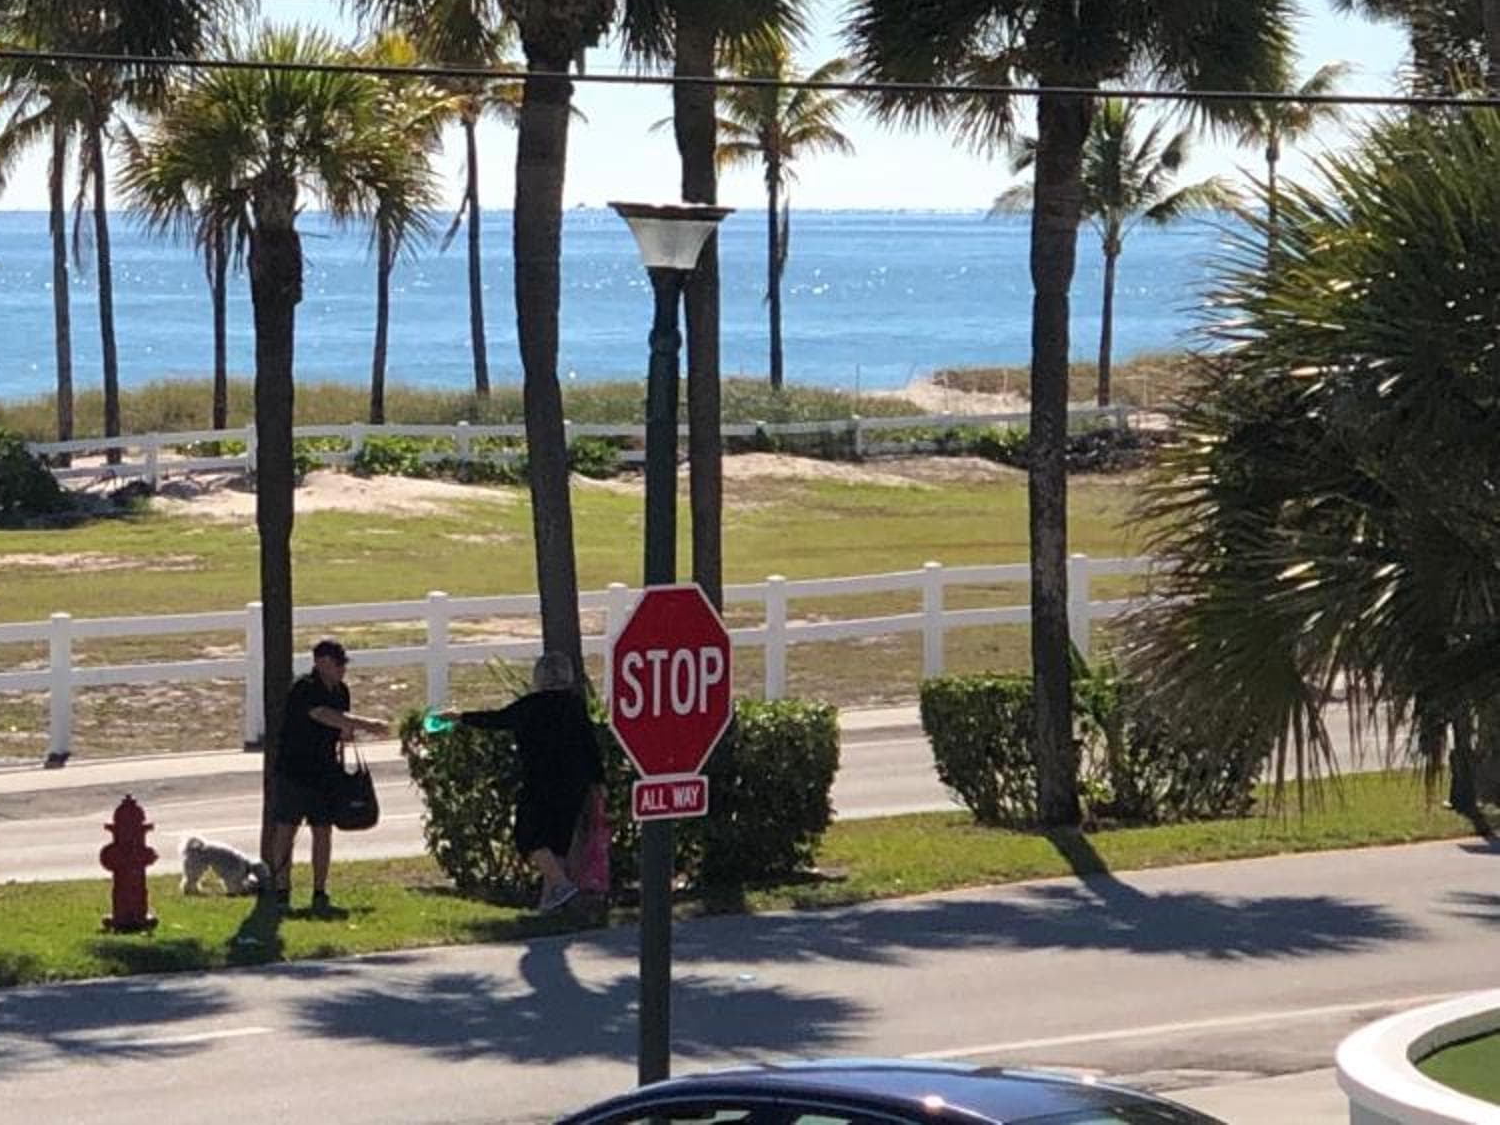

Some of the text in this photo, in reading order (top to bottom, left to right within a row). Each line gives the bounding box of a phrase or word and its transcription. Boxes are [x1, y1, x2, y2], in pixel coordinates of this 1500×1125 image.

[619, 646, 724, 718] STOP
[641, 784, 700, 811] ALL WAY
